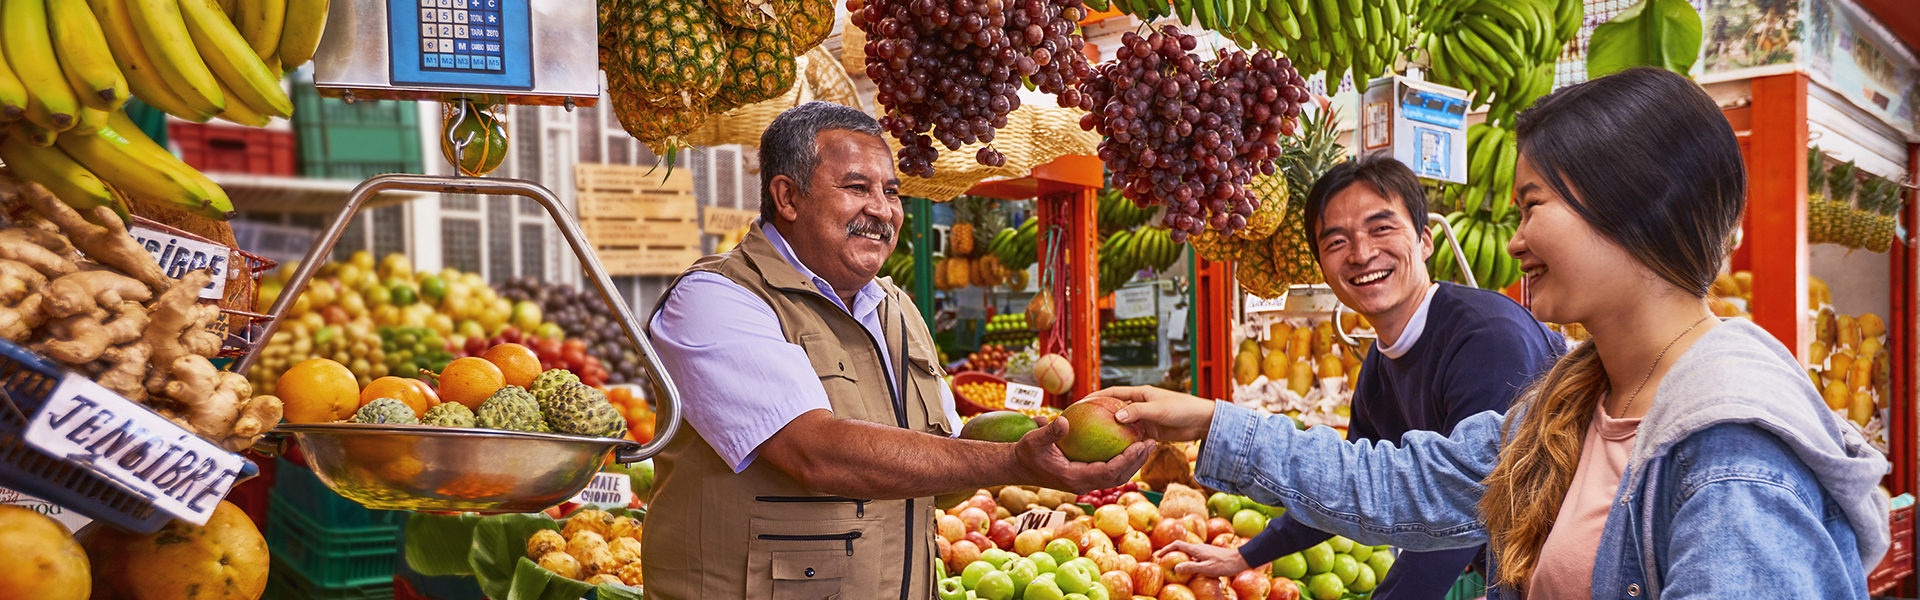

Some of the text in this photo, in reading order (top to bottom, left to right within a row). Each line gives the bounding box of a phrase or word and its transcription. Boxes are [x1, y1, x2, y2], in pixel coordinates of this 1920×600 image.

[426, 11, 484, 22] 4 5 6 TOTAL
[442, 27, 449, 35] 2
[459, 27, 465, 36] 3
[470, 28, 484, 36] TARA
[458, 42, 466, 50] M
[581, 489, 621, 503] CHONTO
